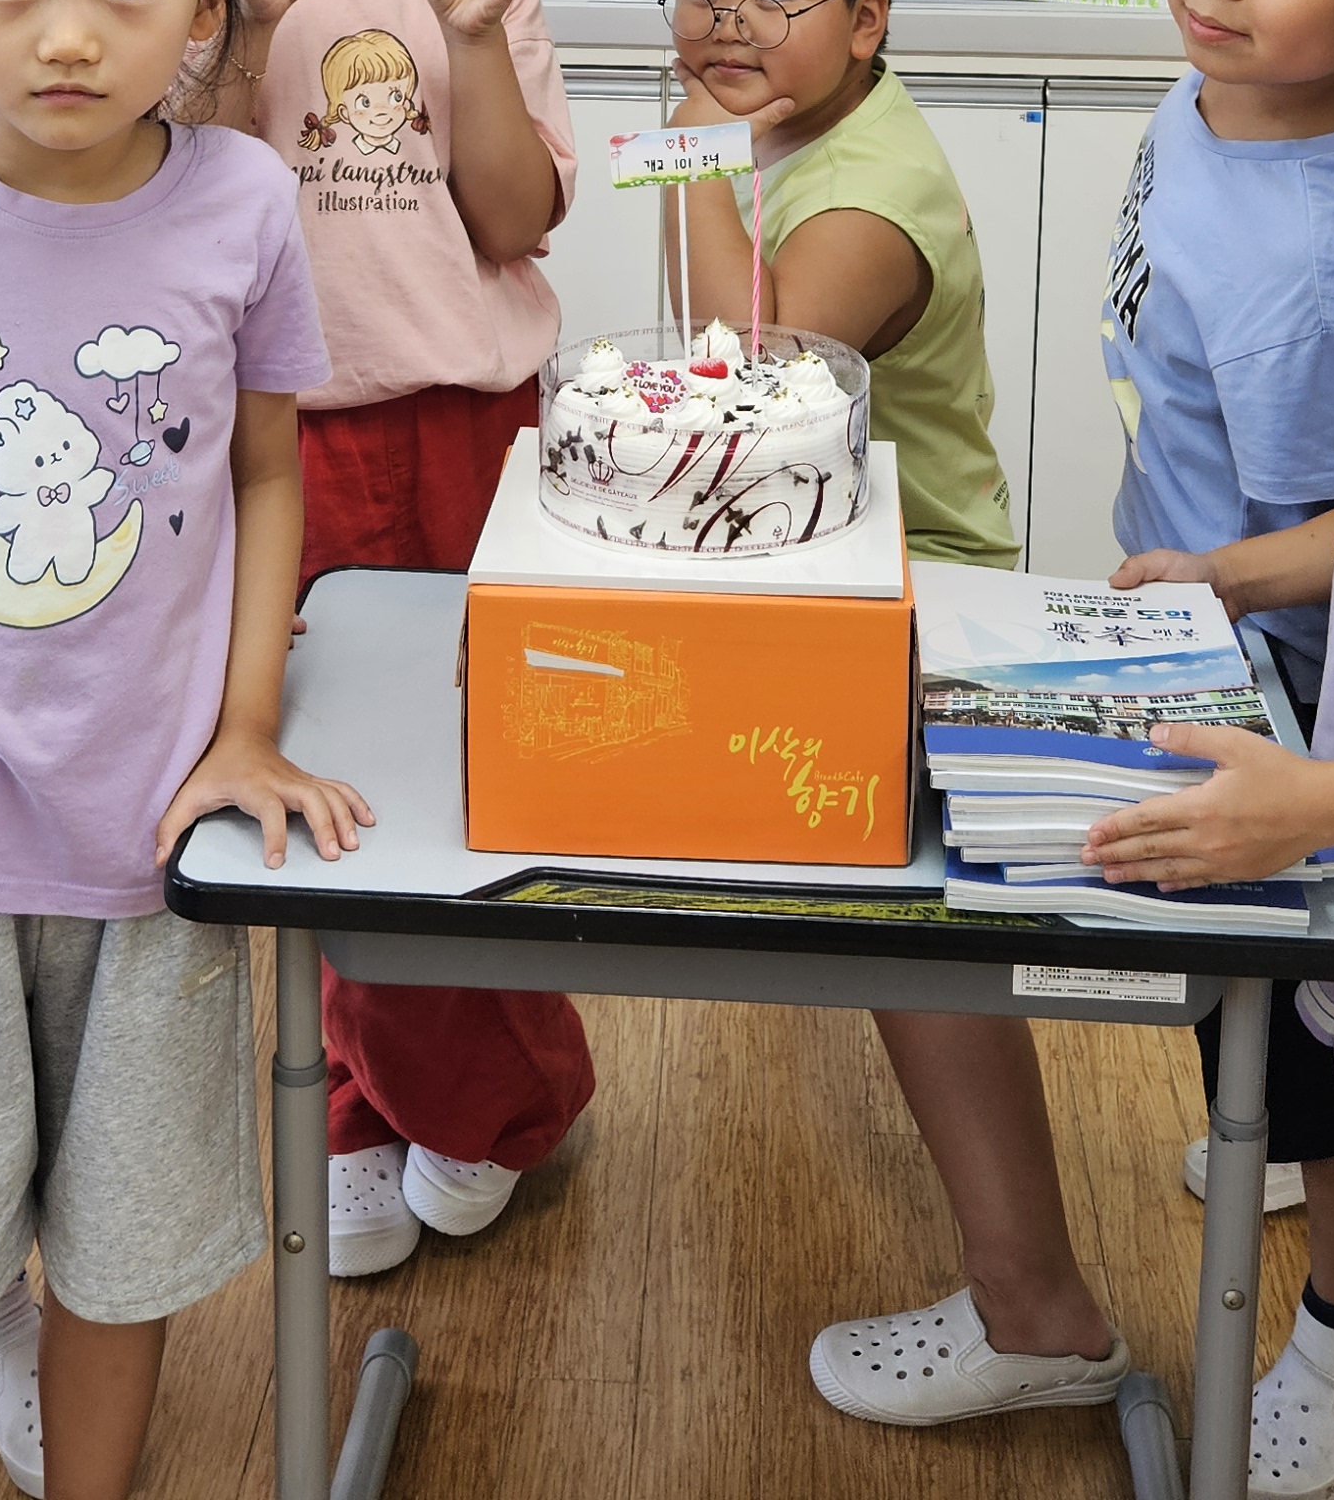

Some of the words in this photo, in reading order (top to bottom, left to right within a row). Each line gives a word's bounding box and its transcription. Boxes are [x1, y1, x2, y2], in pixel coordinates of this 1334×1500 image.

[644, 159, 664, 172] 개교
[674, 158, 692, 169] 101
[702, 153, 720, 171] 주년
[318, 190, 419, 211] illustration
[639, 380, 658, 391] LOVE
[660, 384, 676, 393] YOU
[114, 455, 179, 506] Sweet
[1045, 603, 1128, 618] 새로운
[1136, 609, 1192, 621] 도약
[787, 760, 879, 842] 향기
